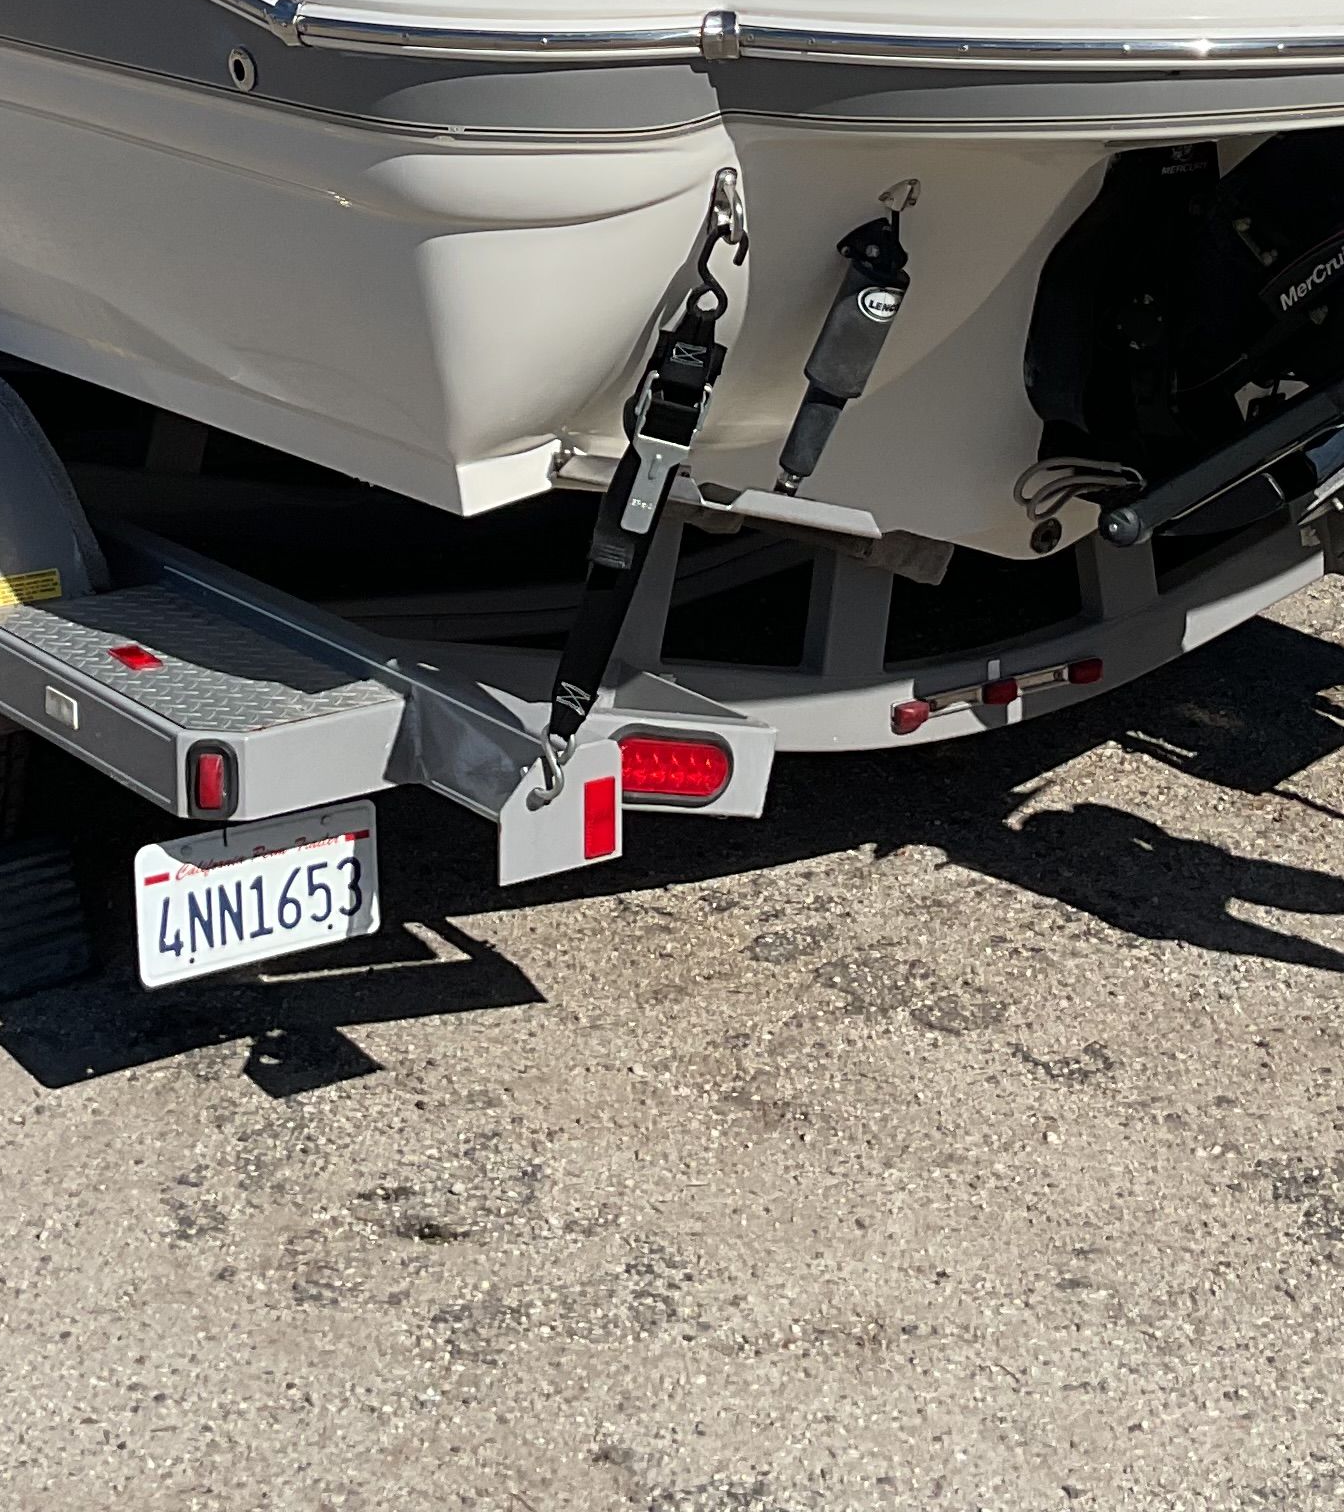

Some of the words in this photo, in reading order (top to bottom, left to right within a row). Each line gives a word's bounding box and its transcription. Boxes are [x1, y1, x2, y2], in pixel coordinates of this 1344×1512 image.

[174, 854, 245, 881] California
[252, 844, 287, 859] Perm
[294, 832, 340, 851] Trailer
[158, 856, 363, 957] 4NN1653
